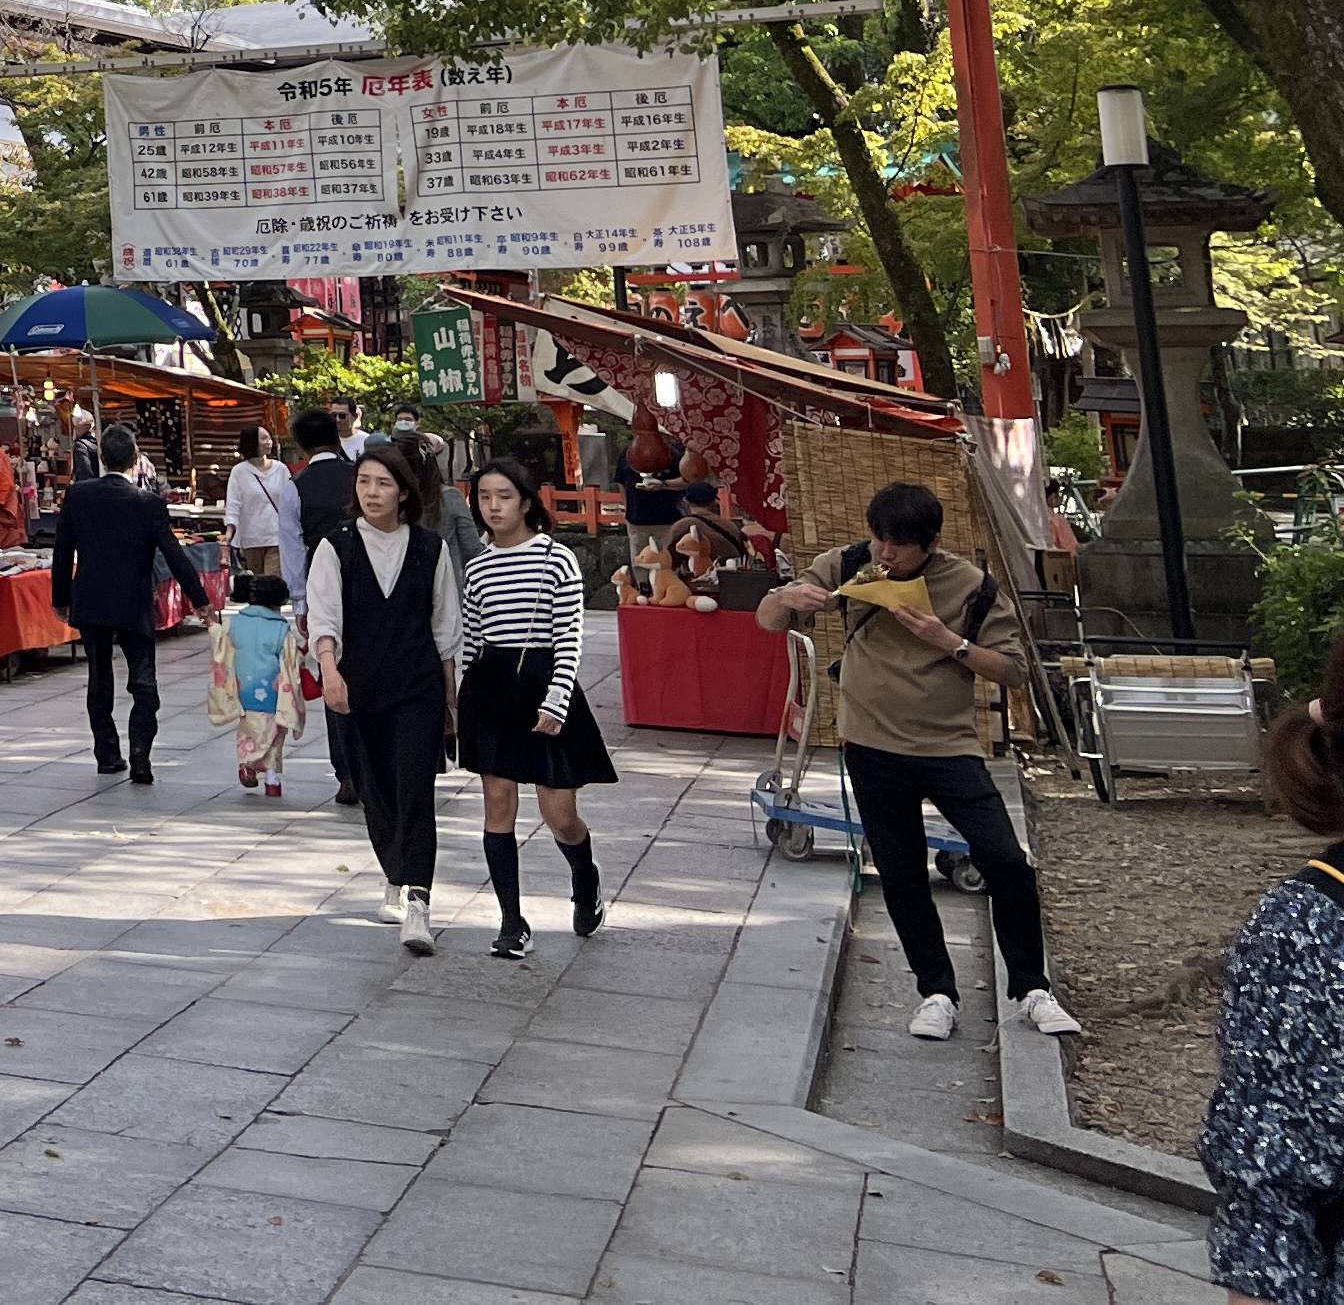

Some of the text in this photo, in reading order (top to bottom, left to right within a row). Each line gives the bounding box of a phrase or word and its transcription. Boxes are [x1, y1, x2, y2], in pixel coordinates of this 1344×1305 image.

[277, 64, 513, 101] 令和5年 厄年表 (数え年)
[421, 91, 667, 120] 女性 前厄 本厄 後厄
[138, 113, 358, 137] 男性 前厄 本厄 後厄
[424, 112, 686, 139] 19歳 平成18年生 平成17年生 平成16年生
[137, 133, 375, 157] 25歳 平成12年生 平成11年生 平成10年生
[424, 138, 685, 164] 33歳 平成4年生 平成3年生 平成2年生
[140, 157, 377, 180] 42歳 昭和58年生 昭和57年生 昭和56年生
[426, 162, 693, 189] 37歳 昭和63年生 昭和62年生 昭和61年生
[143, 182, 379, 203] 61歳 昭和39年生 昭和38年生 昭和37年生
[585, 228, 638, 240] 大正14年生
[668, 223, 717, 236] 大正5年生
